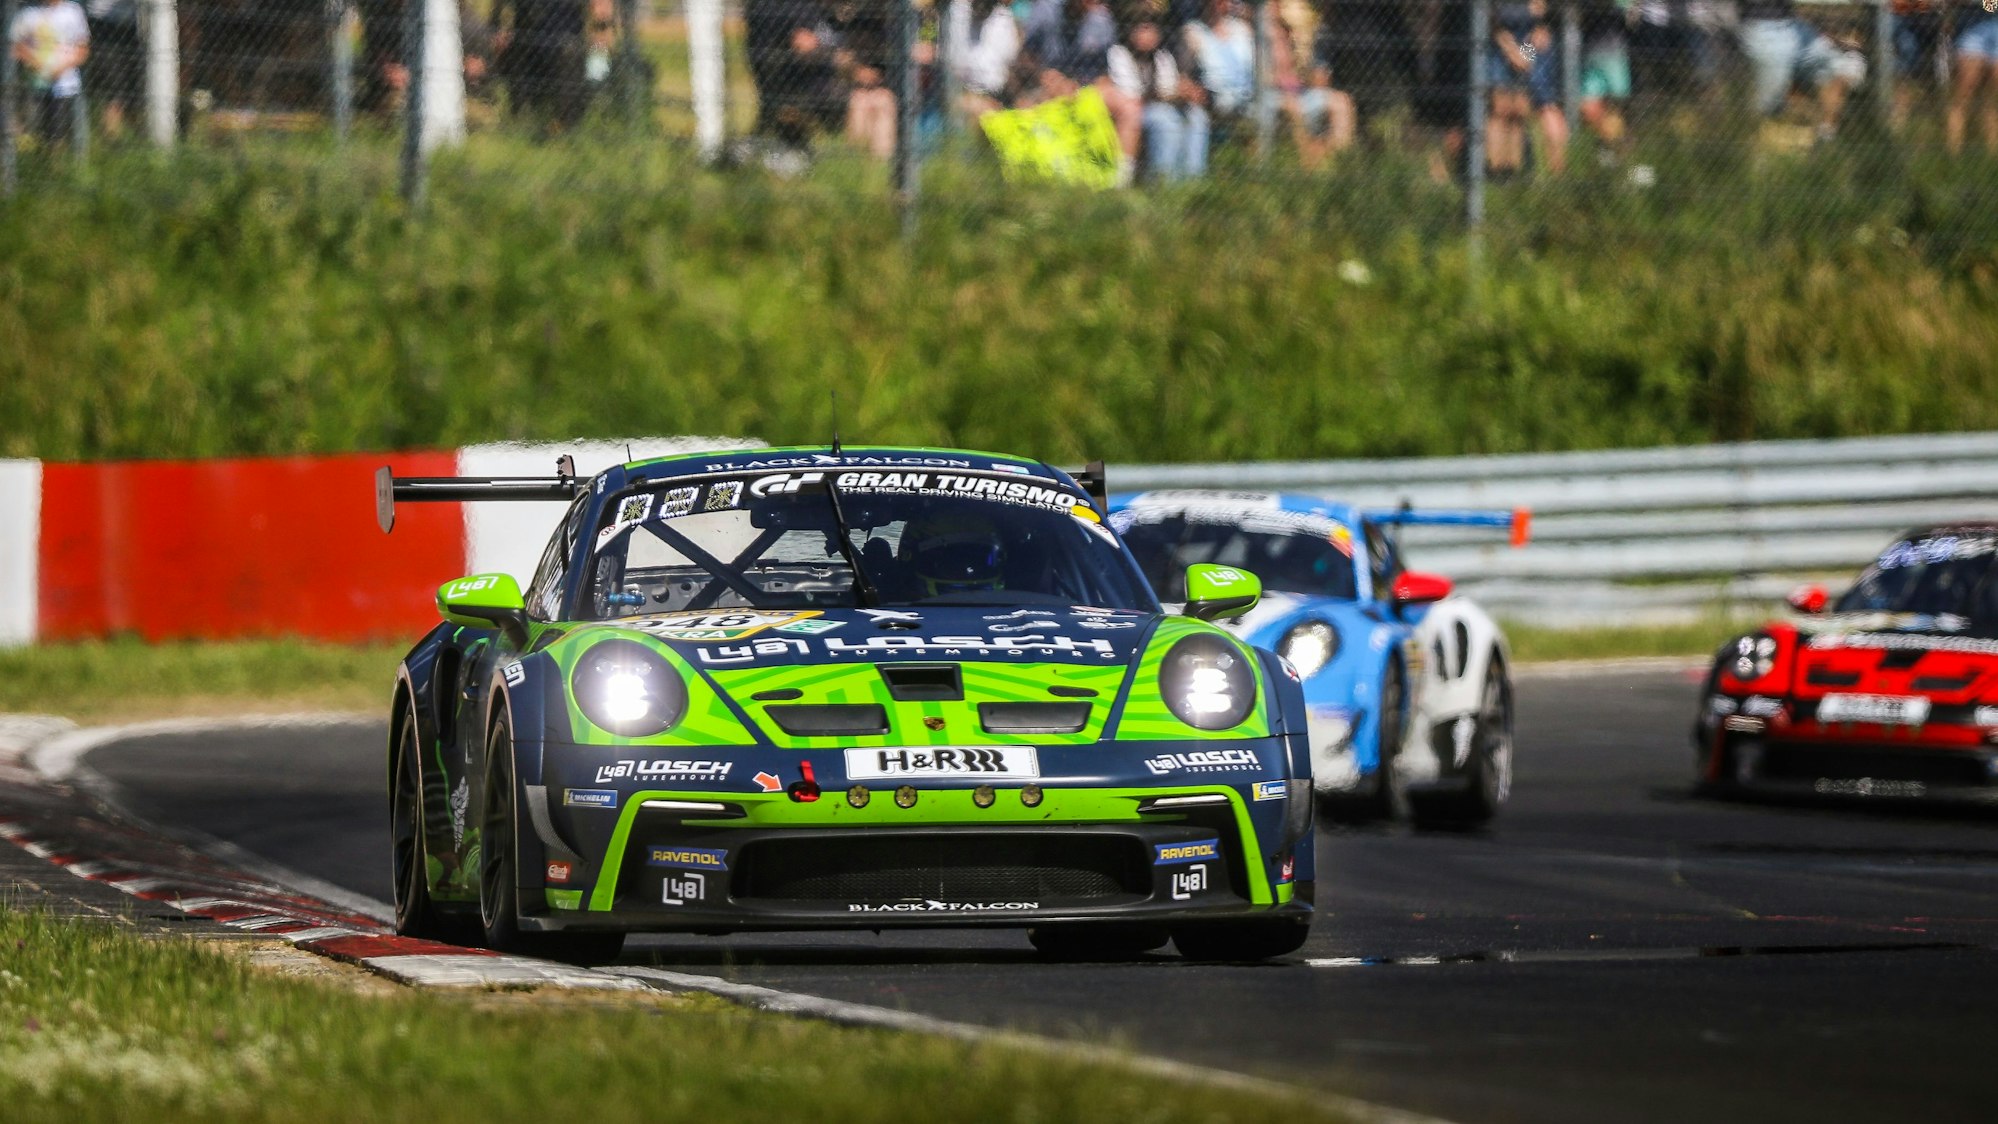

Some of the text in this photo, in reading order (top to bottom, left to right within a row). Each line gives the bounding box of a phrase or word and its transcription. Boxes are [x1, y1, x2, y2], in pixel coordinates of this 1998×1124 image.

[705, 456, 970, 472] BLACK FALCON
[836, 473, 1076, 507] GRAN TURISMO
[839, 487, 874, 495] THE
[878, 487, 915, 495] REAL
[919, 487, 984, 499] DRIVING
[824, 635, 1114, 653] LOSCH
[828, 648, 1116, 658] LUXEMBOURG
[1180, 750, 1259, 766] LOSCH
[637, 760, 732, 775] LOSCH
[1186, 765, 1263, 773] LUXEMBOURG
[574, 794, 610, 803] MICHELIN
[652, 851, 720, 865] RAVENOL
[1160, 845, 1215, 860] RAVENOL
[848, 902, 1039, 912] BLACK FALCON
